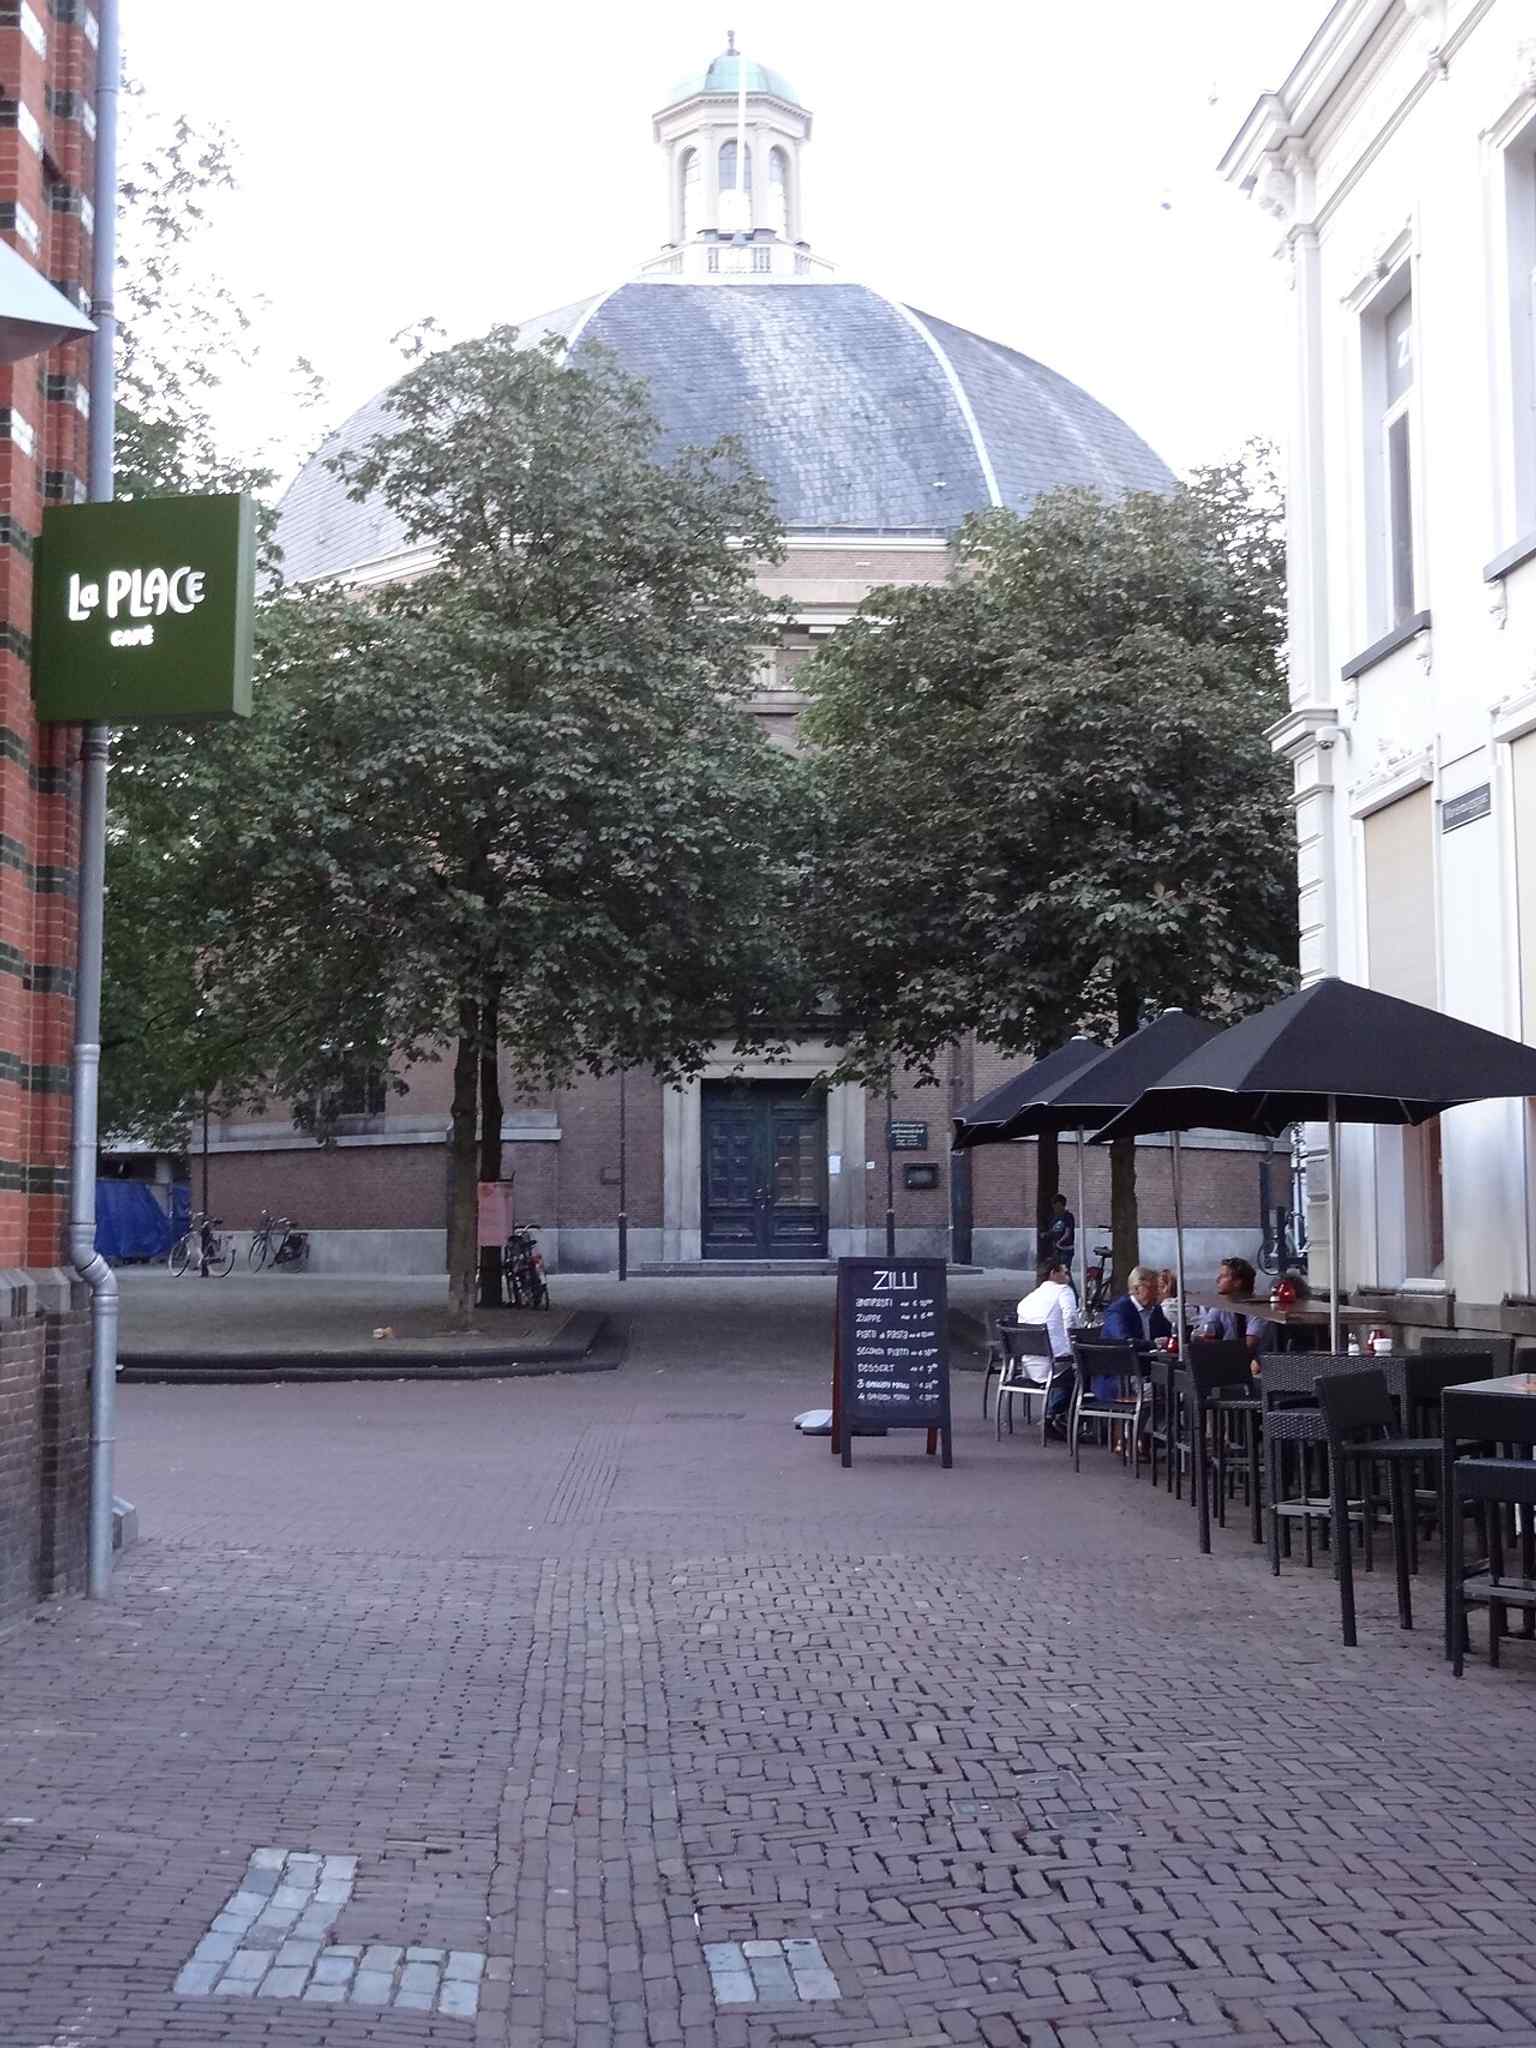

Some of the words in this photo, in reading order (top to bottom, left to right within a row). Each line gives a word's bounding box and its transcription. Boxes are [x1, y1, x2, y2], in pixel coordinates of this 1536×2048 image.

[68, 573, 100, 621] La
[107, 566, 205, 618] PLACE
[873, 1270, 918, 1291] ZILLI
[858, 1363, 896, 1373] DESSERT
